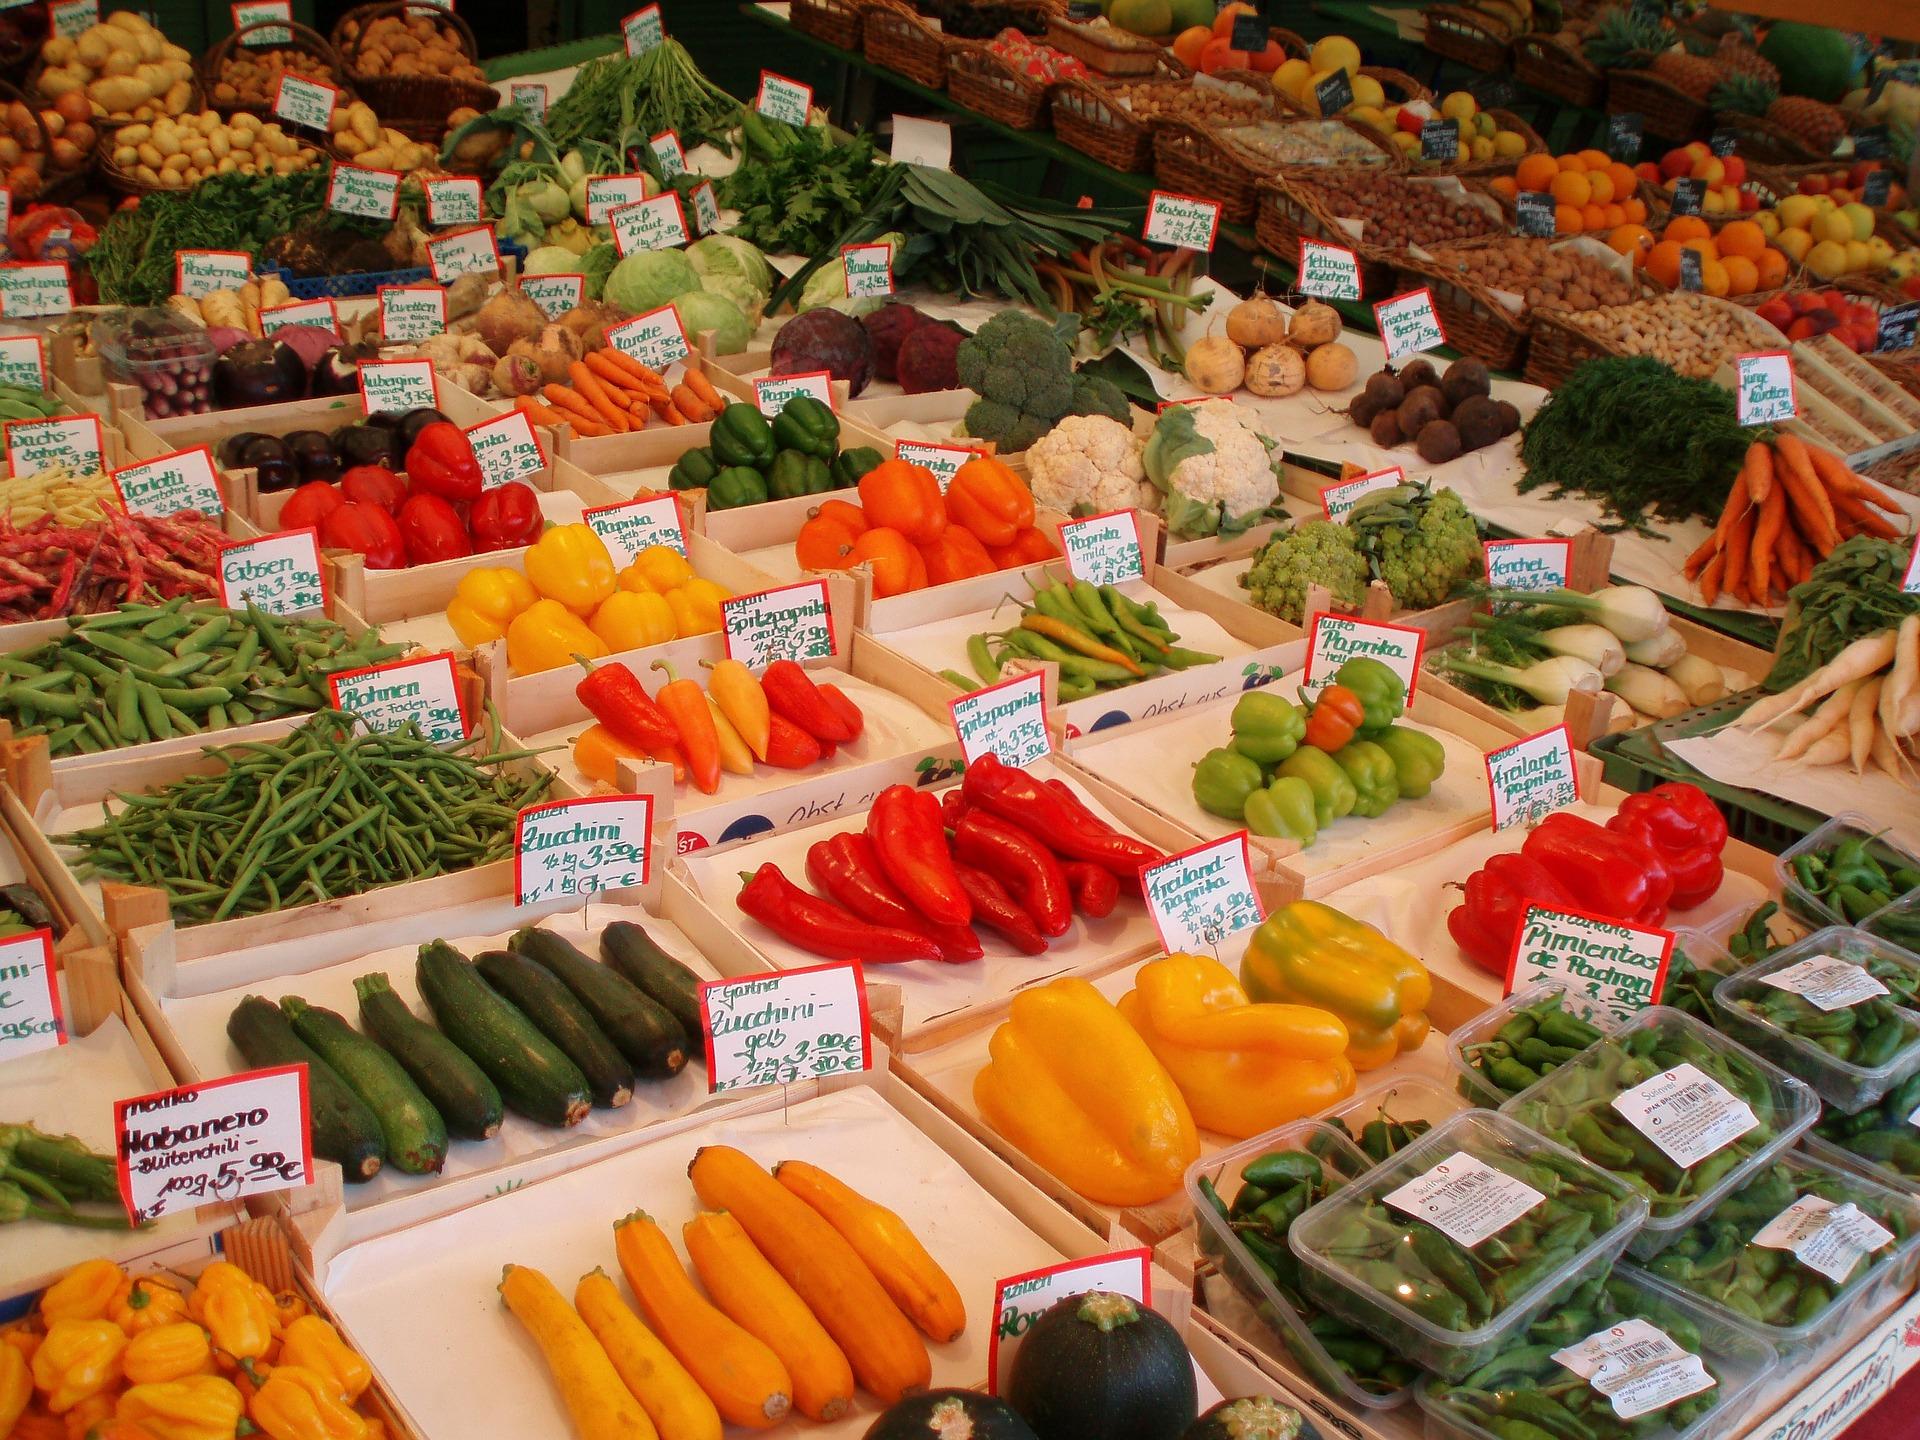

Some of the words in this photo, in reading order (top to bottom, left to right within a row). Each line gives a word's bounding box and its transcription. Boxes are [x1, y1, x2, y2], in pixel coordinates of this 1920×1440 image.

[1066, 526, 1121, 552] Paprika
[224, 558, 294, 583] Erbsen
[1490, 556, 1550, 577] Fenchel
[1321, 629, 1408, 659] Paprika
[340, 681, 421, 711] Bohnen
[1503, 769, 1568, 804] paprika
[522, 817, 624, 853] Zucchini
[1160, 877, 1230, 915] paprika
[1523, 921, 1662, 970] Pimientos
[1526, 951, 1559, 970] de
[1566, 954, 1653, 998] Padron
[711, 993, 834, 1039] Zucchini-
[733, 1028, 788, 1064] gelb
[120, 1108, 269, 1162] Habanero
